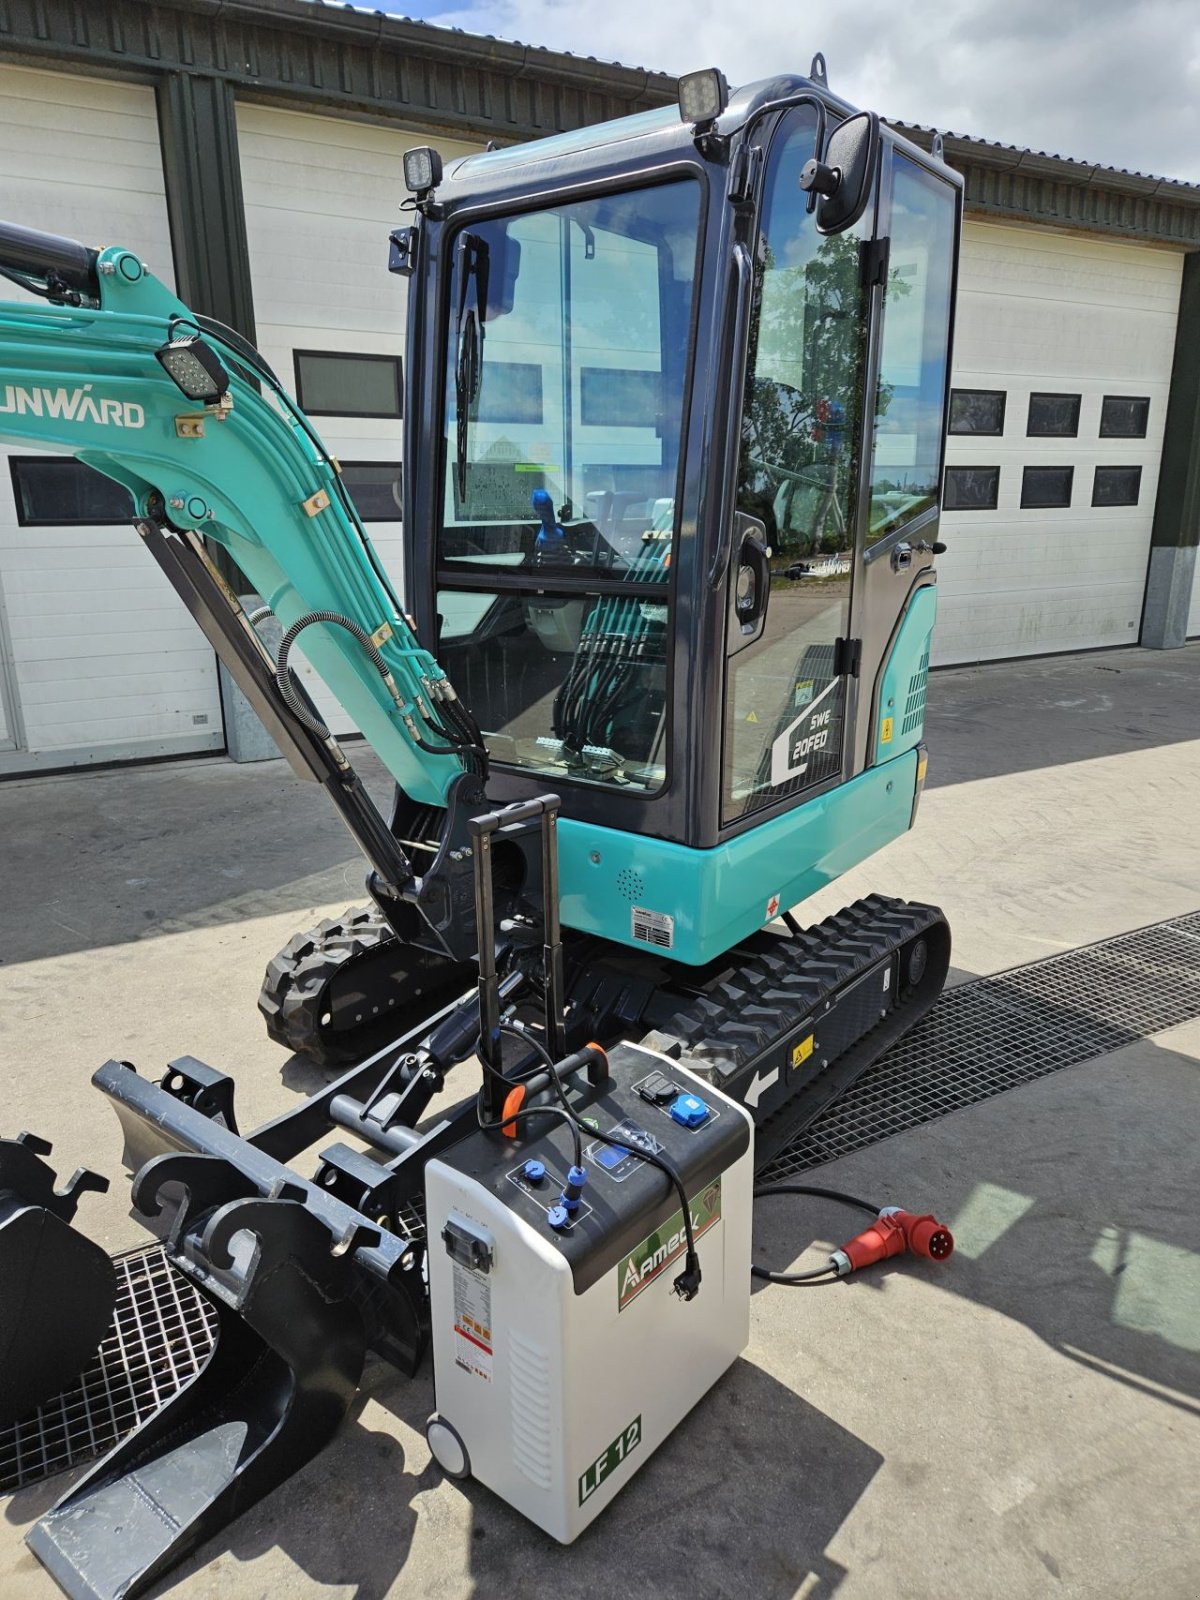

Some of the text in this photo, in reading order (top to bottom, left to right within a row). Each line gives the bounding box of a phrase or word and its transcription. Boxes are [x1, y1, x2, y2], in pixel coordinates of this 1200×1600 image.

[809, 709, 832, 731] SWE
[792, 729, 829, 760] 20FED
[581, 1422, 639, 1501] LF 12
